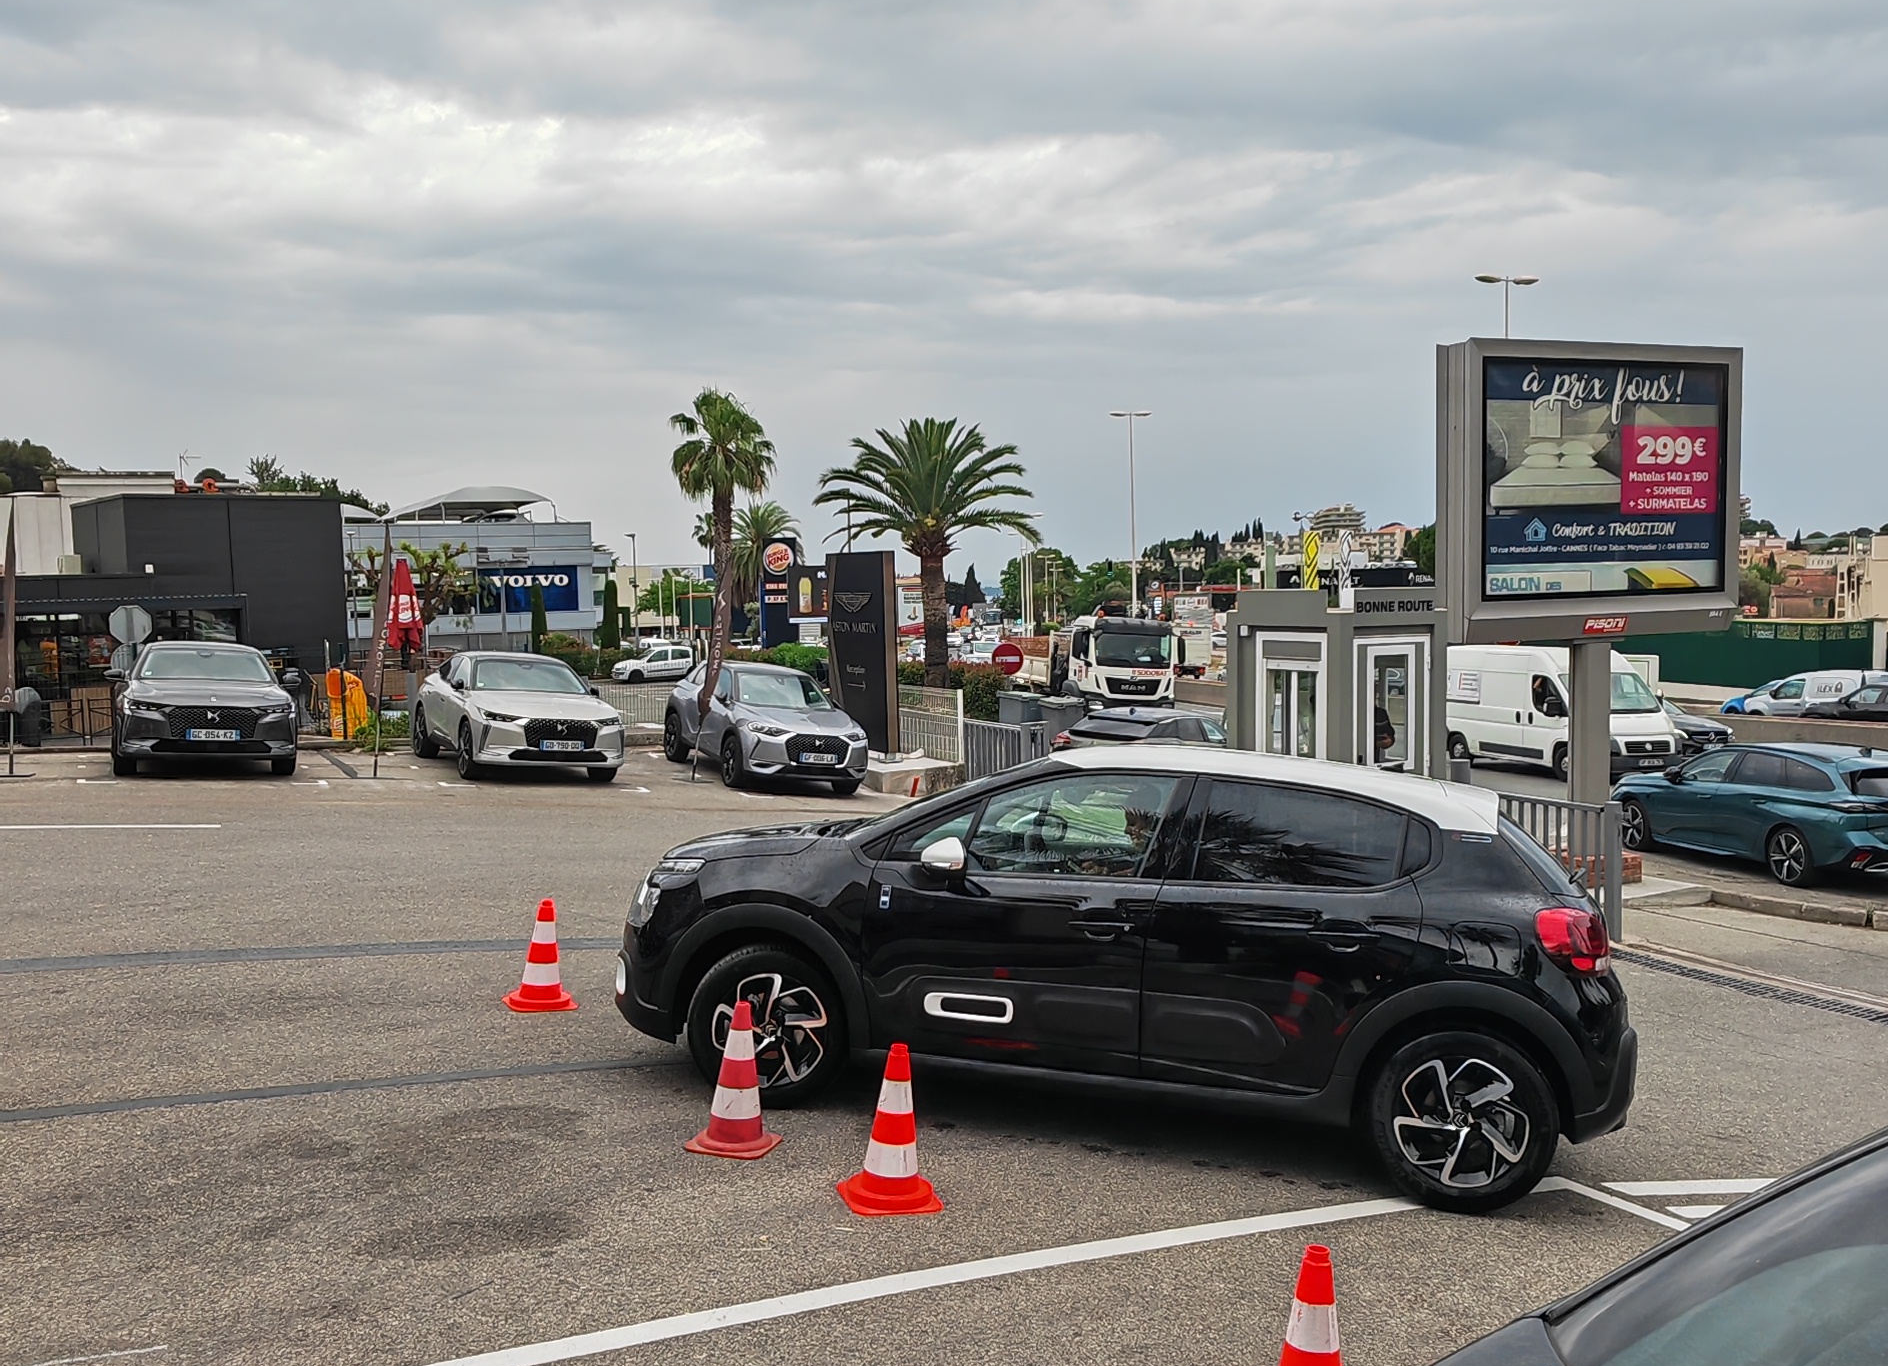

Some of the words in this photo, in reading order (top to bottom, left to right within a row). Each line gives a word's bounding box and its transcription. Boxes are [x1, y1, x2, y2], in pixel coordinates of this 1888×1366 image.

[1522, 364, 1546, 393] à
[1533, 373, 1610, 411] prix
[1636, 436, 1707, 465] 299€
[1628, 471, 1666, 483] Matelas
[1667, 471, 1683, 482] 140
[1684, 474, 1691, 482] x
[1692, 471, 1709, 482] 190
[1653, 486, 1693, 496] SOMMIER
[1637, 498, 1707, 510] SURMATELAS
[1552, 522, 1596, 539] Confort
[1607, 521, 1677, 536] TRADITION
[1561, 544, 1588, 552] CANNES
[768, 553, 790, 567] KING
[490, 574, 570, 588] VOLVO
[1489, 576, 1541, 593] SALON
[1356, 600, 1396, 614] BONNE
[1397, 599, 1434, 612] ROUTE
[852, 622, 877, 634] MARTIN
